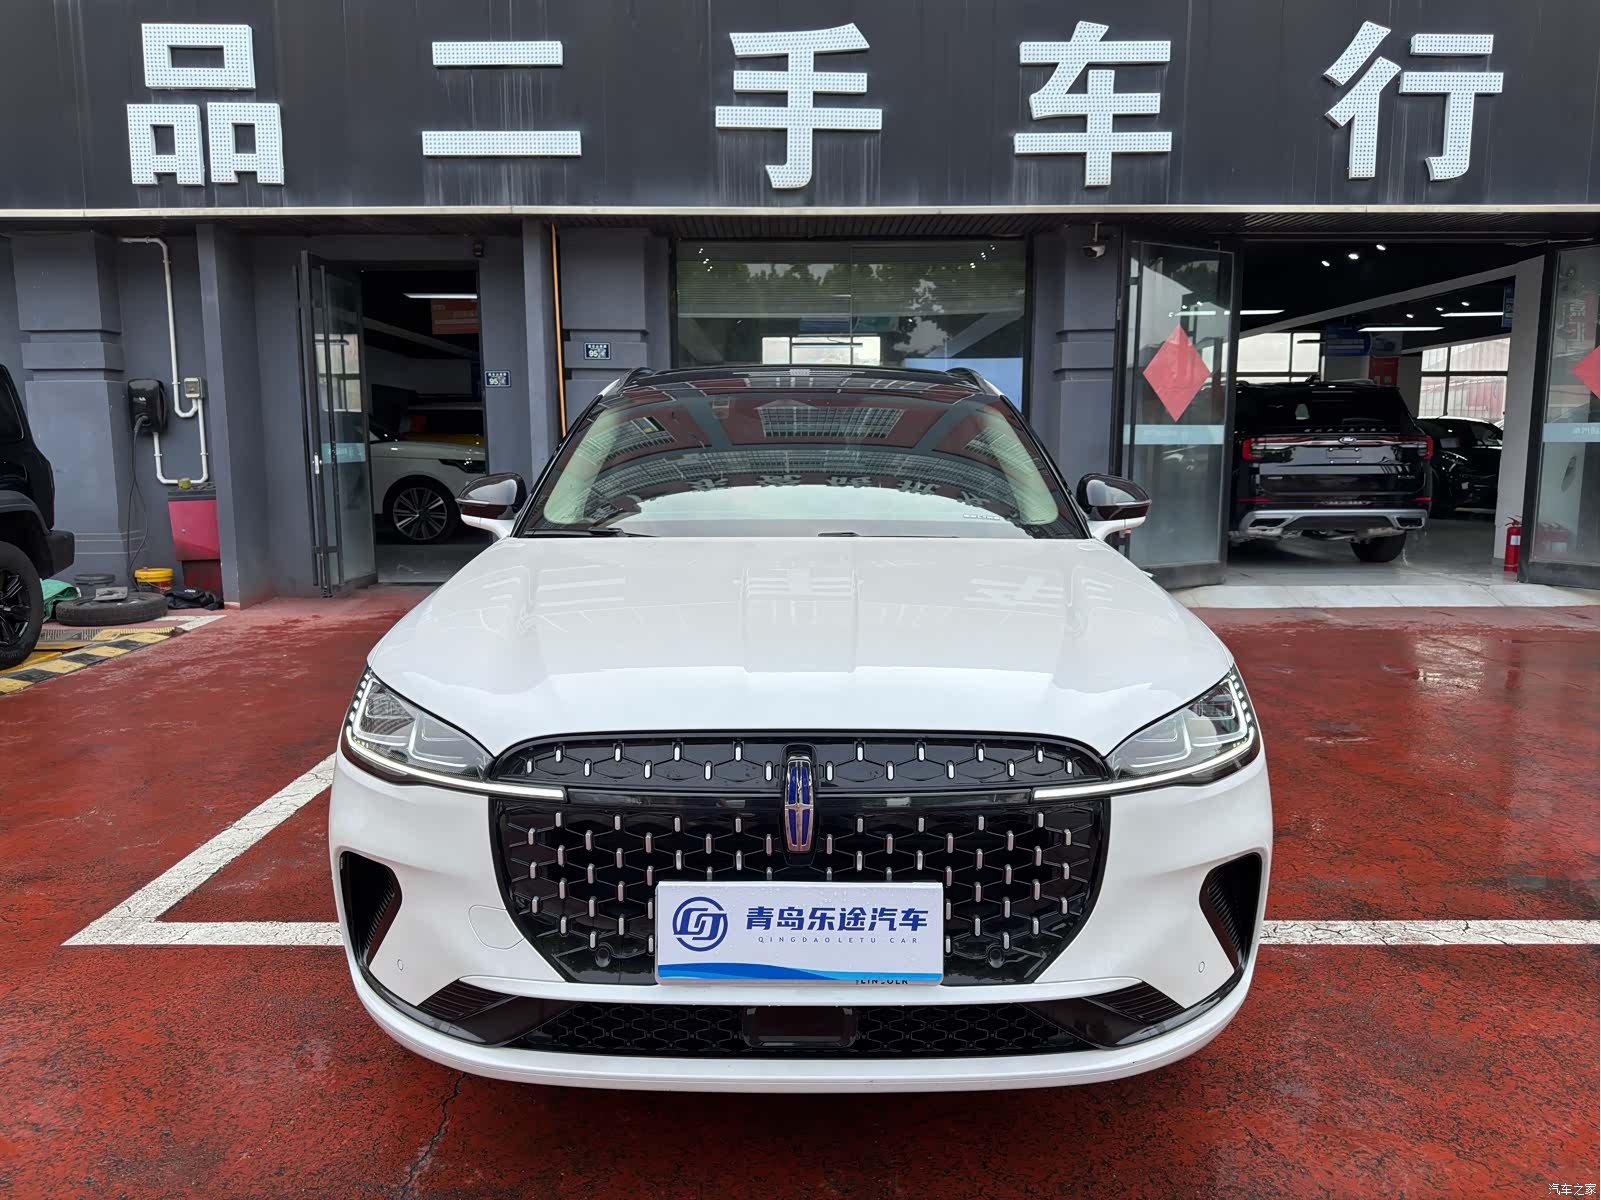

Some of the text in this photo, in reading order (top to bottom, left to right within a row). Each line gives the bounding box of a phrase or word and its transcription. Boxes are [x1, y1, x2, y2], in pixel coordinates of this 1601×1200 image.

[127, 21, 1504, 189] 品二手车行
[746, 906, 928, 931] 青岛乐途汽车
